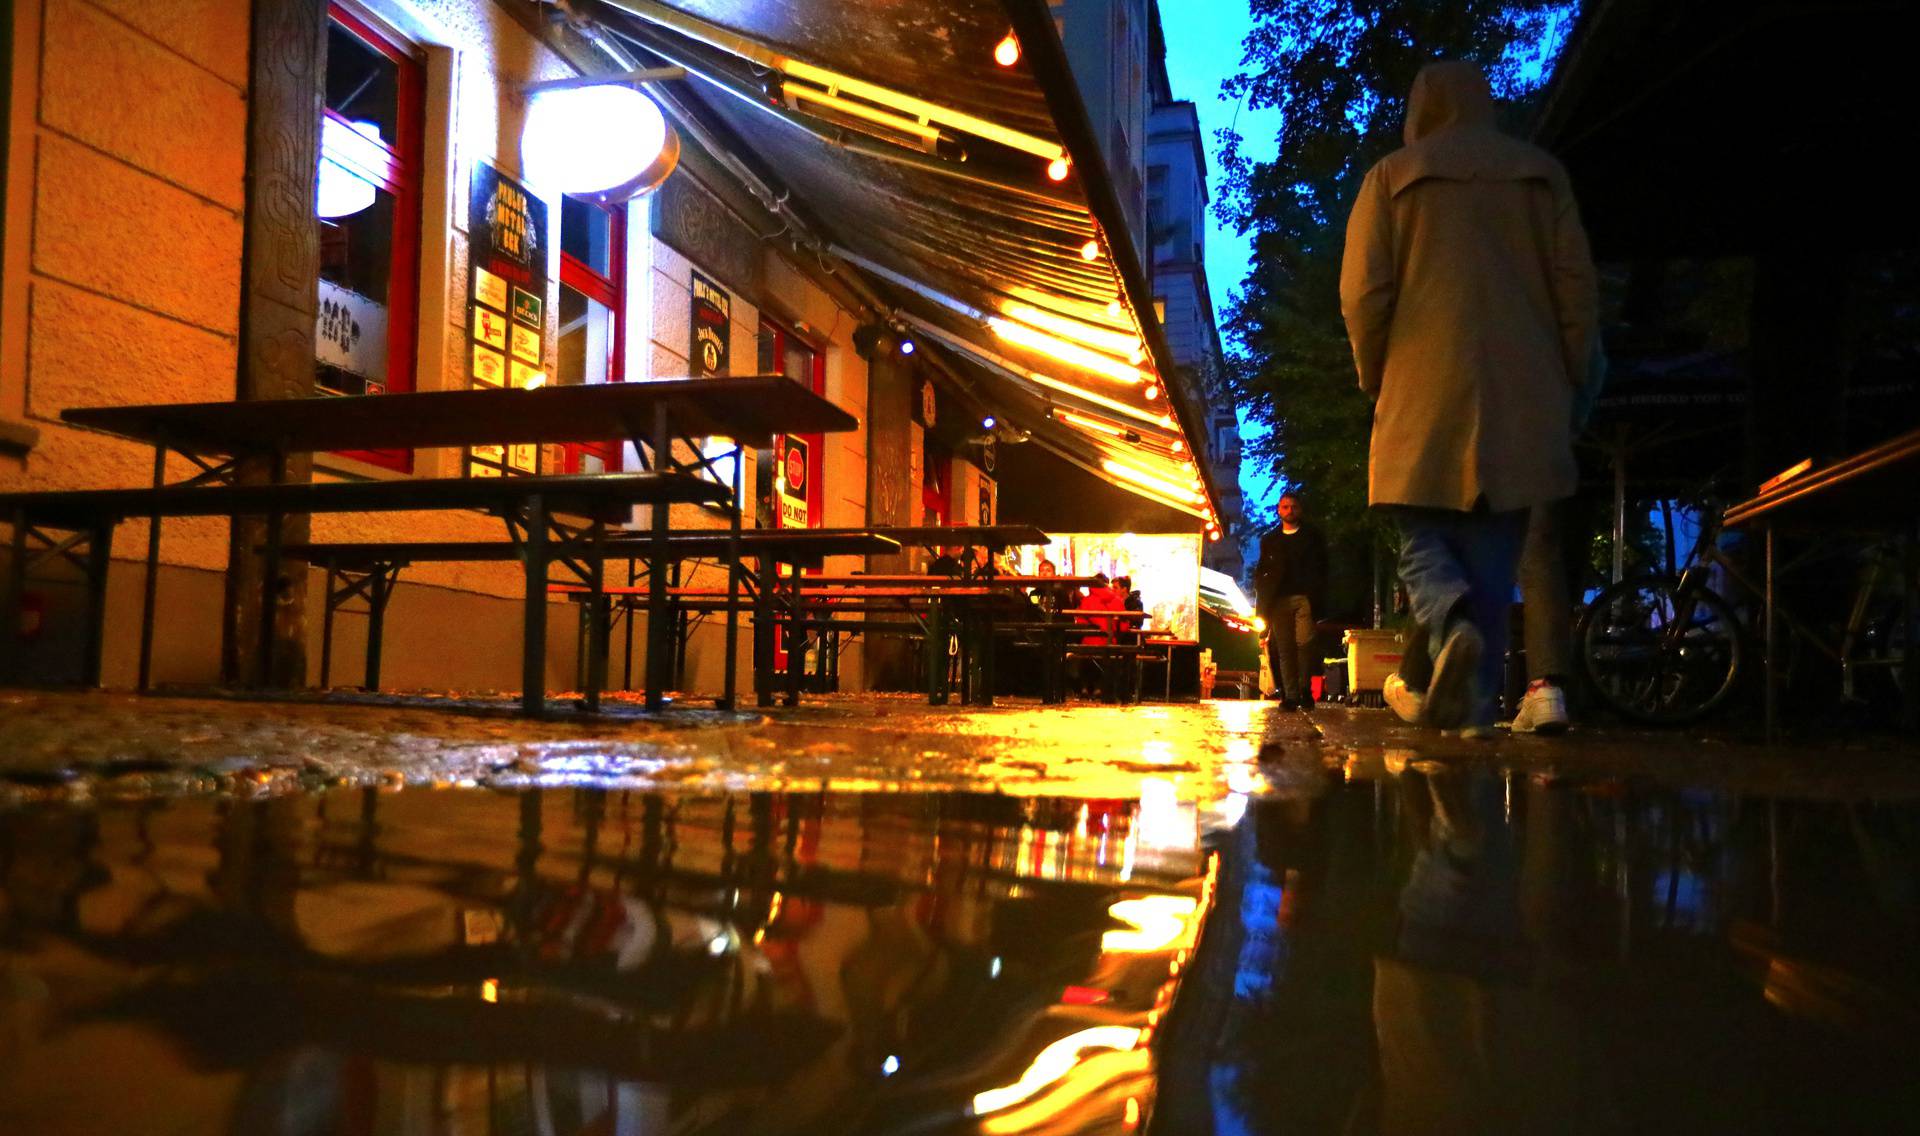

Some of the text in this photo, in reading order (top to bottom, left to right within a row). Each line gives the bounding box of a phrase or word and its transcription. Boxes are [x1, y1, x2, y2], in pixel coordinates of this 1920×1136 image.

[497, 204, 527, 237] METAL
[516, 306, 538, 321] BECK'S
[788, 460, 803, 477] STOP
[782, 503, 807, 521] DO NOT
